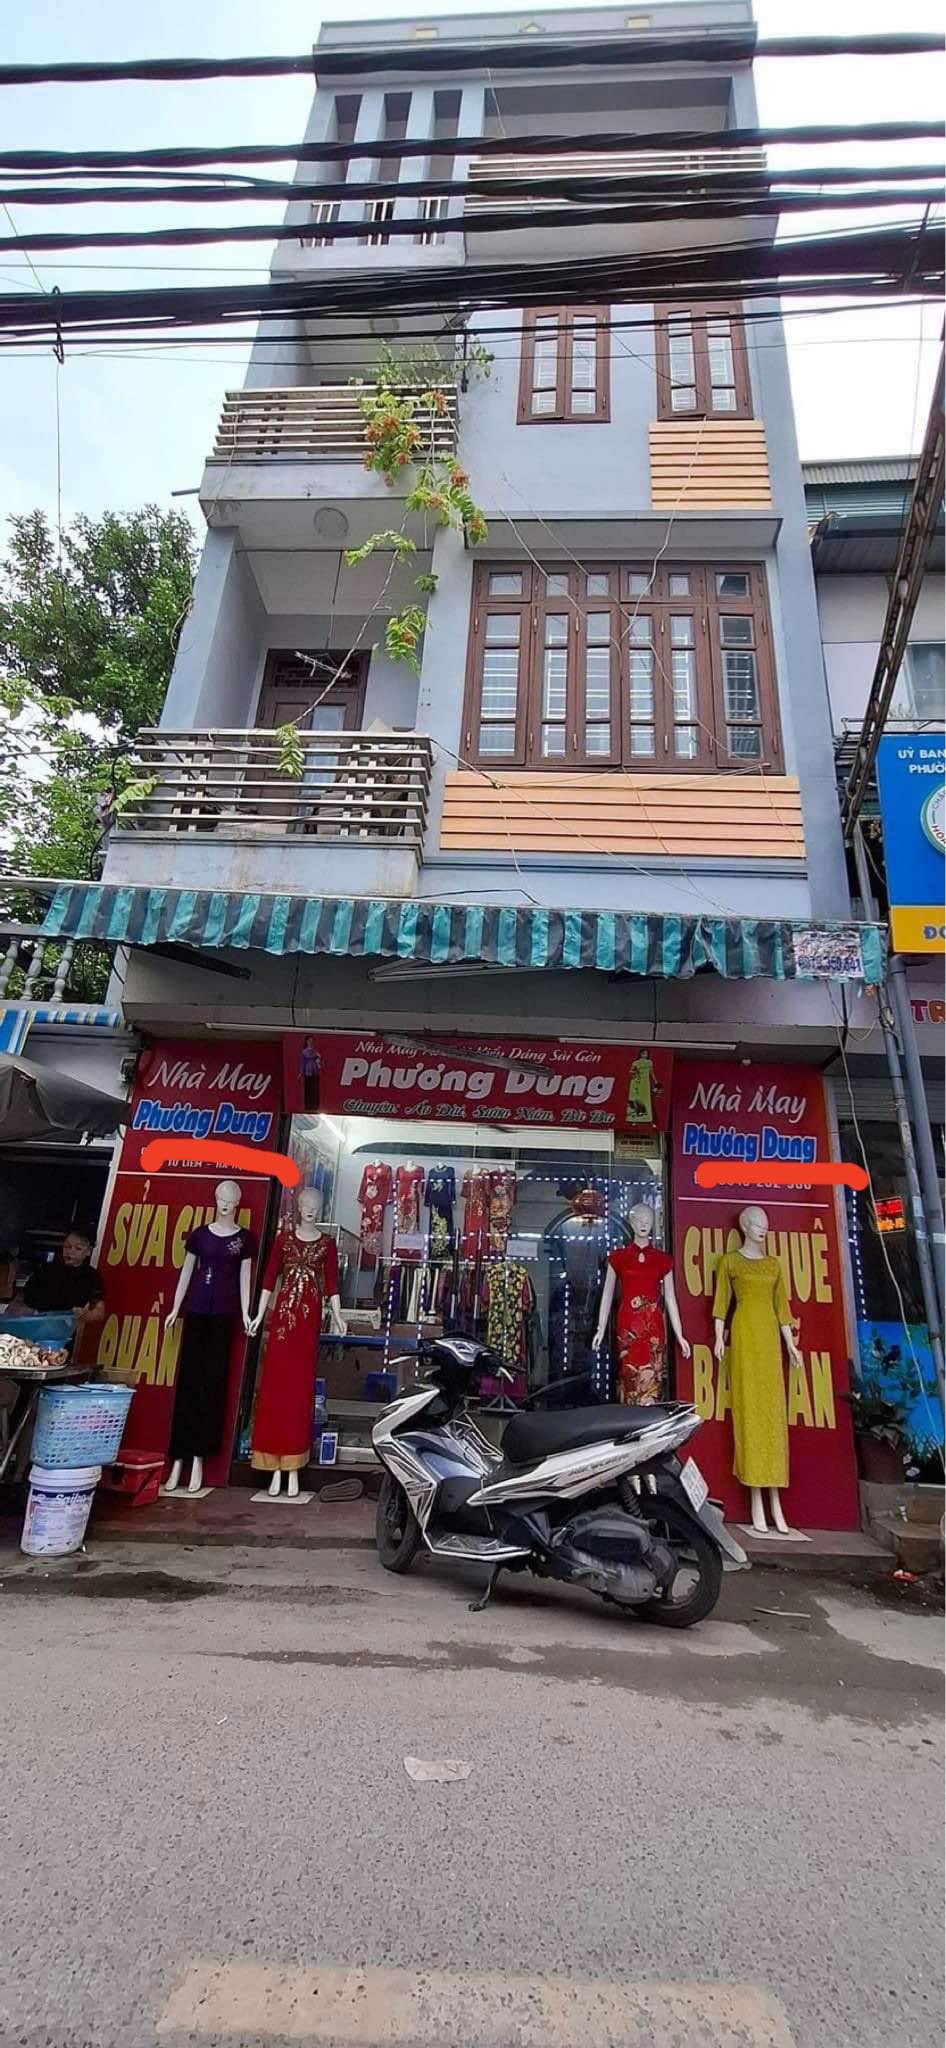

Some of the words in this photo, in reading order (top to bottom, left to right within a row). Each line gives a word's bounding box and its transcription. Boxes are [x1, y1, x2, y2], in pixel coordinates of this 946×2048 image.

[919, 750, 946, 759] BAN
[355, 1041, 384, 1054] Nhà
[386, 1045, 418, 1059] May
[508, 1047, 547, 1063] Dáng
[549, 1049, 573, 1062] Sài
[575, 1050, 602, 1063] Gòn
[147, 1060, 207, 1089] Nhà
[208, 1063, 272, 1100] May
[340, 1057, 496, 1100] Phương
[504, 1070, 616, 1105] Dung
[132, 1098, 215, 1139] Phương
[213, 1102, 274, 1143] Dung
[404, 1099, 432, 1116] Áo
[688, 1081, 743, 1113] Nhà
[748, 1085, 807, 1124] May
[682, 1122, 761, 1162] Phương
[761, 1126, 818, 1163] Dung
[106, 1179, 169, 1268] SỬA
[96, 1291, 184, 1387] QUẦN
